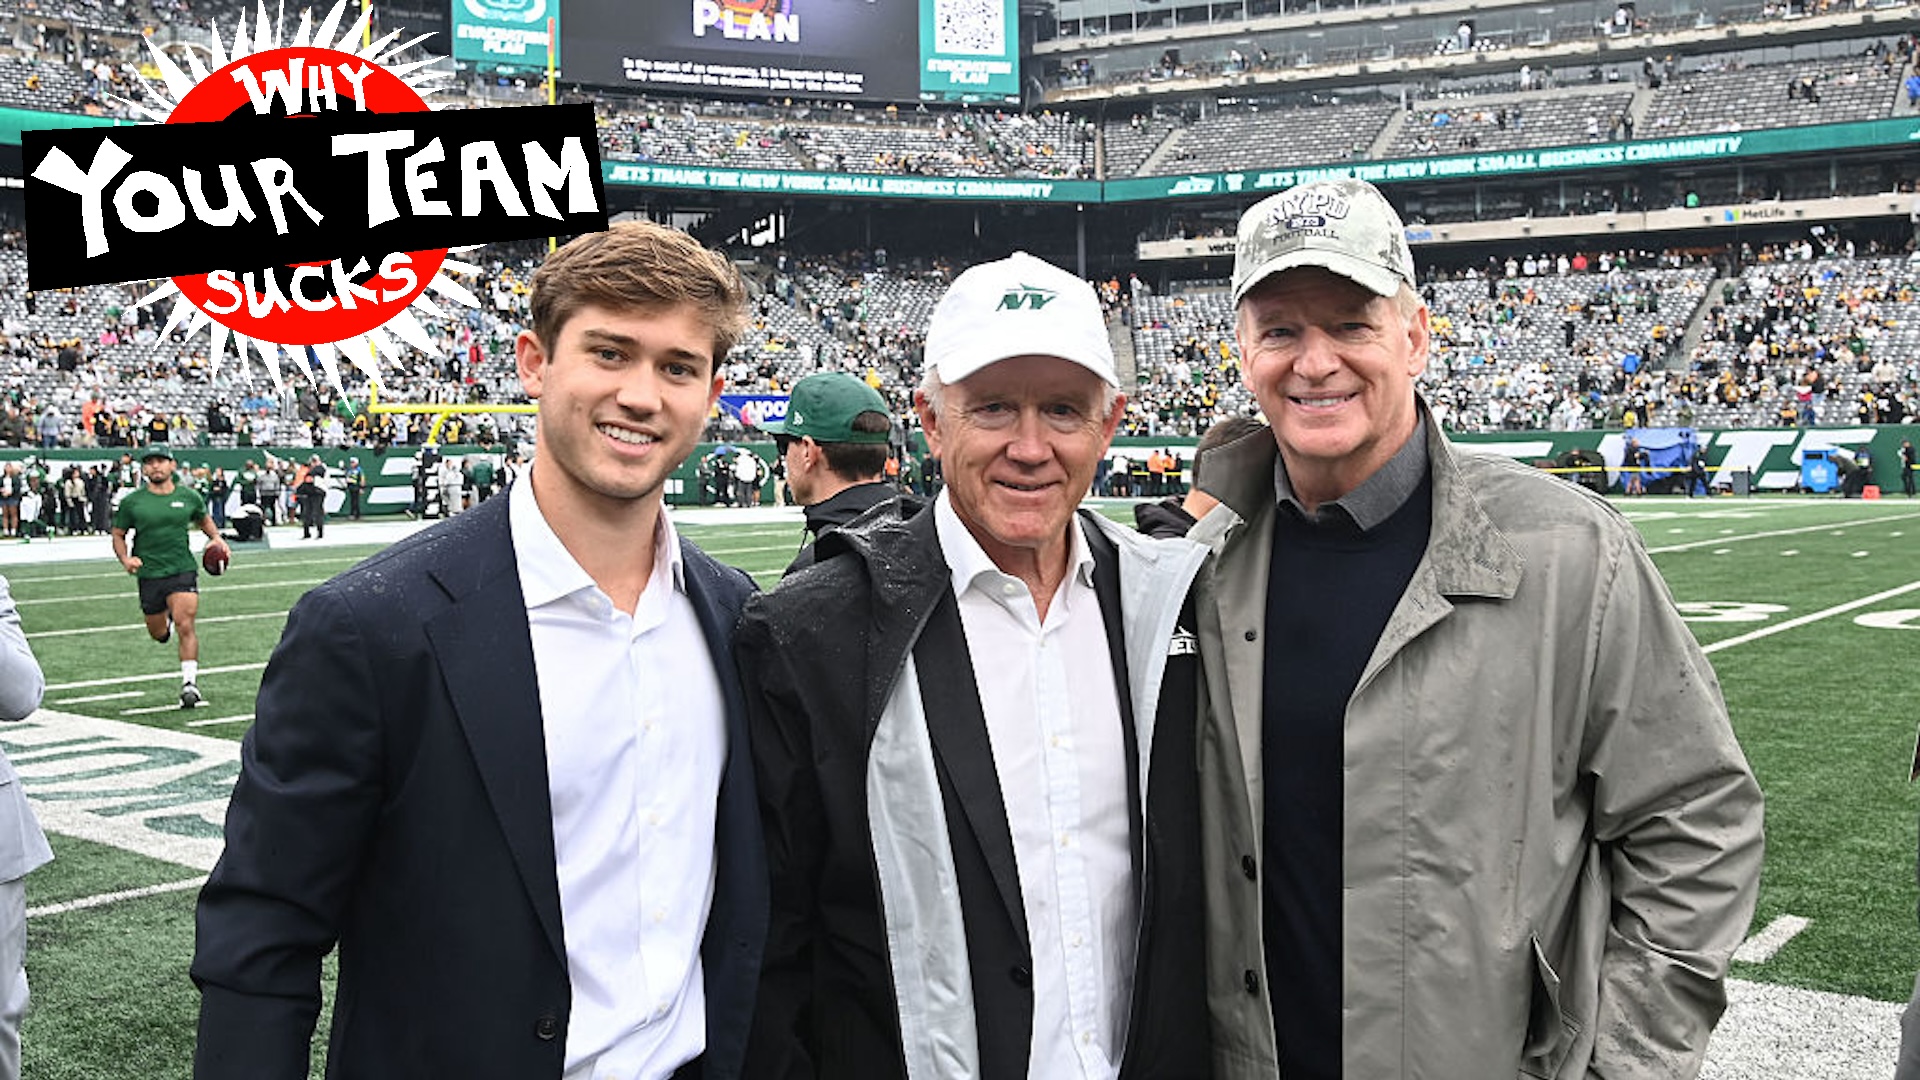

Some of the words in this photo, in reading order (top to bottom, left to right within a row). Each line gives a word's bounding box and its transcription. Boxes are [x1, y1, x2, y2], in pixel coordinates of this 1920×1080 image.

[693, 0, 799, 42] PLAN
[1254, 172, 1295, 188] JETS
[1295, 167, 1352, 184] THANK
[1353, 165, 1386, 181] THE
[1387, 162, 1427, 178] NEW
[1429, 158, 1476, 175] YORK
[1477, 154, 1537, 171] SMALL
[1539, 146, 1625, 167] BUSINESS
[1625, 137, 1742, 160] COMMUNITY
[609, 166, 650, 181] JETS
[653, 168, 708, 185] THANK
[708, 171, 740, 187] THE
[740, 173, 780, 188] NEW
[782, 175, 826, 190] YORK
[827, 177, 880, 192] SMALL
[882, 179, 955, 195] BUSINESS
[957, 181, 1053, 198] COMMUNITY
[1266, 190, 1350, 227] NYPD
[1743, 207, 1785, 218] MetLife
[1272, 228, 1339, 245] FOOTBALL
